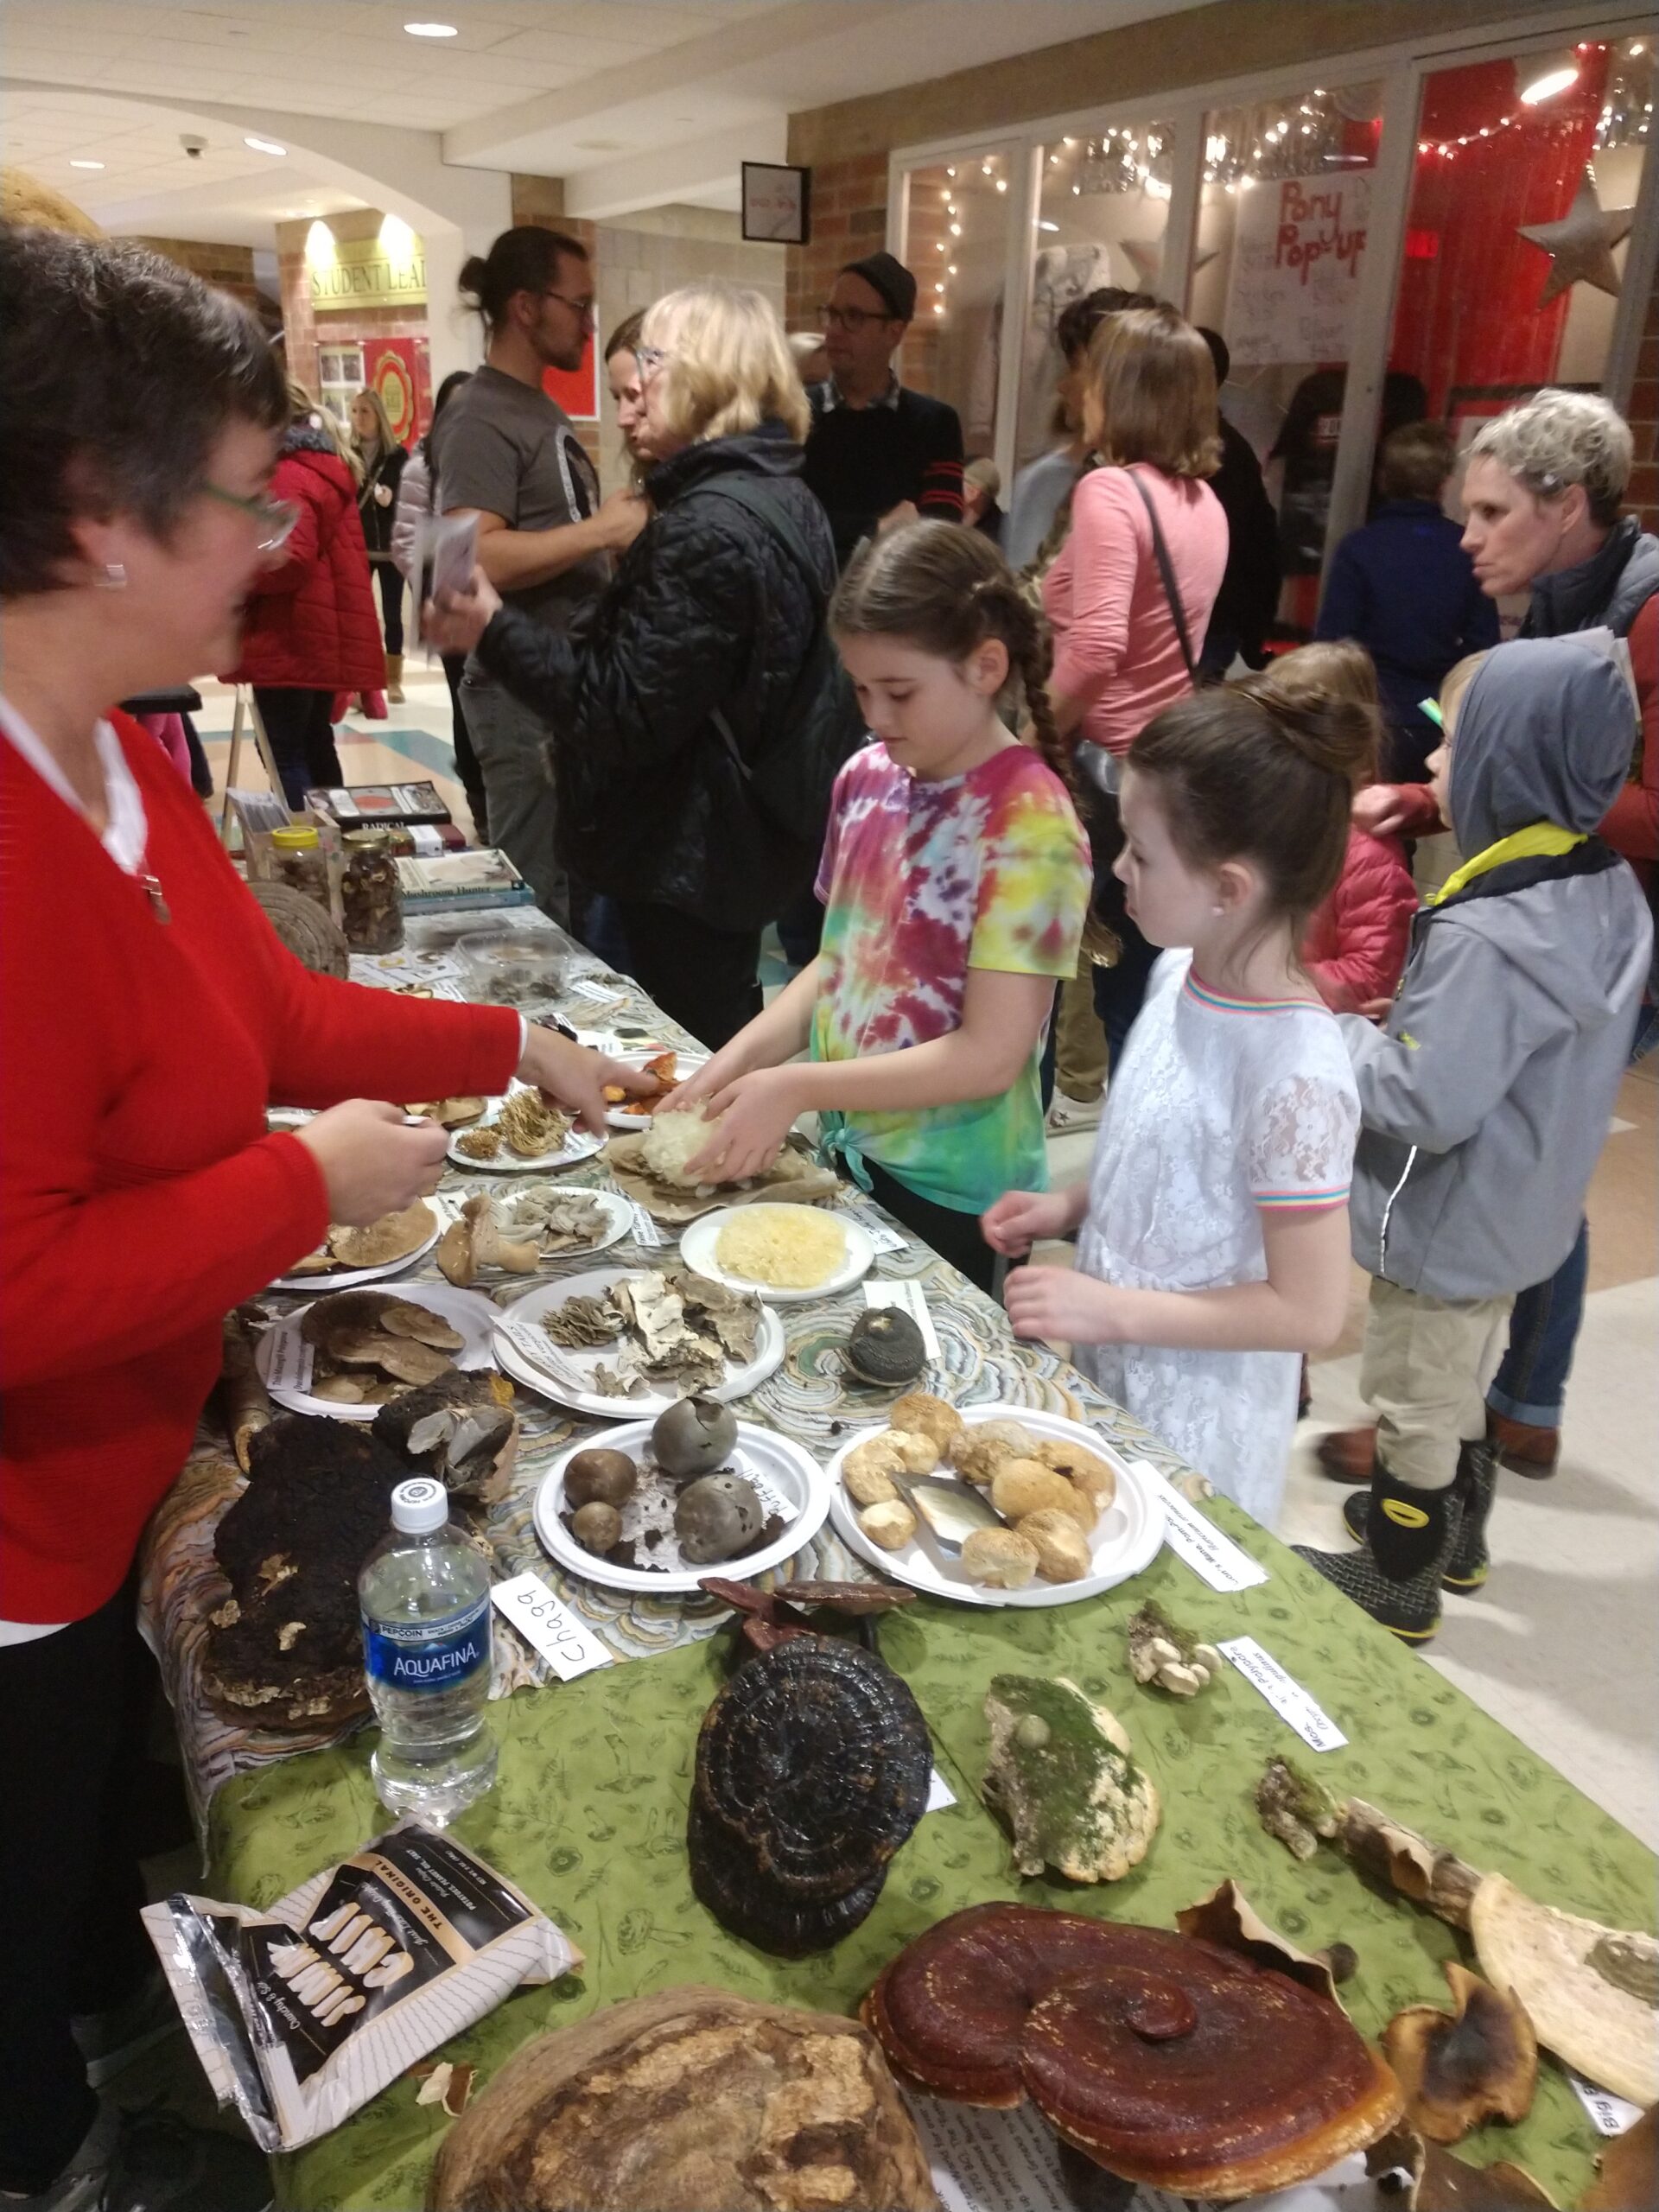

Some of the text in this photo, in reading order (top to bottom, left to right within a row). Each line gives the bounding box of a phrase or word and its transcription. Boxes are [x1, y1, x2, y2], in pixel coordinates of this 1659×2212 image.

[1281, 181, 1342, 242] Pony
[313, 264, 382, 296] STUDENT
[401, 885, 491, 899] Mushroom Hunter
[517, 1589, 585, 1662] Chaga
[394, 1642, 477, 1678] AQUAFINA
[1228, 1645, 1269, 1684] Polypore
[428, 1868, 450, 1886] PEANUT
[374, 1859, 442, 1929] THE ORIGINAL
[448, 1884, 477, 1910] POTATOES,
[406, 1928, 428, 1947] Just
[264, 1991, 276, 2003] &
[275, 1996, 301, 2031] Crunchy
[918, 2107, 935, 2130] over
[1594, 2101, 1619, 2129] Big
[931, 2131, 944, 2149] for
[944, 2127, 961, 2149] The
[1032, 2135, 1046, 2154] the
[938, 2149, 962, 2182] World
[988, 2142, 1007, 2170] early
[1012, 2134, 1039, 2172] Greeks
[968, 2171, 986, 2194] 370
[971, 2144, 1005, 2197] indigenous
[1001, 2169, 1022, 2195] until
[1034, 2171, 1061, 2212] Ancient
